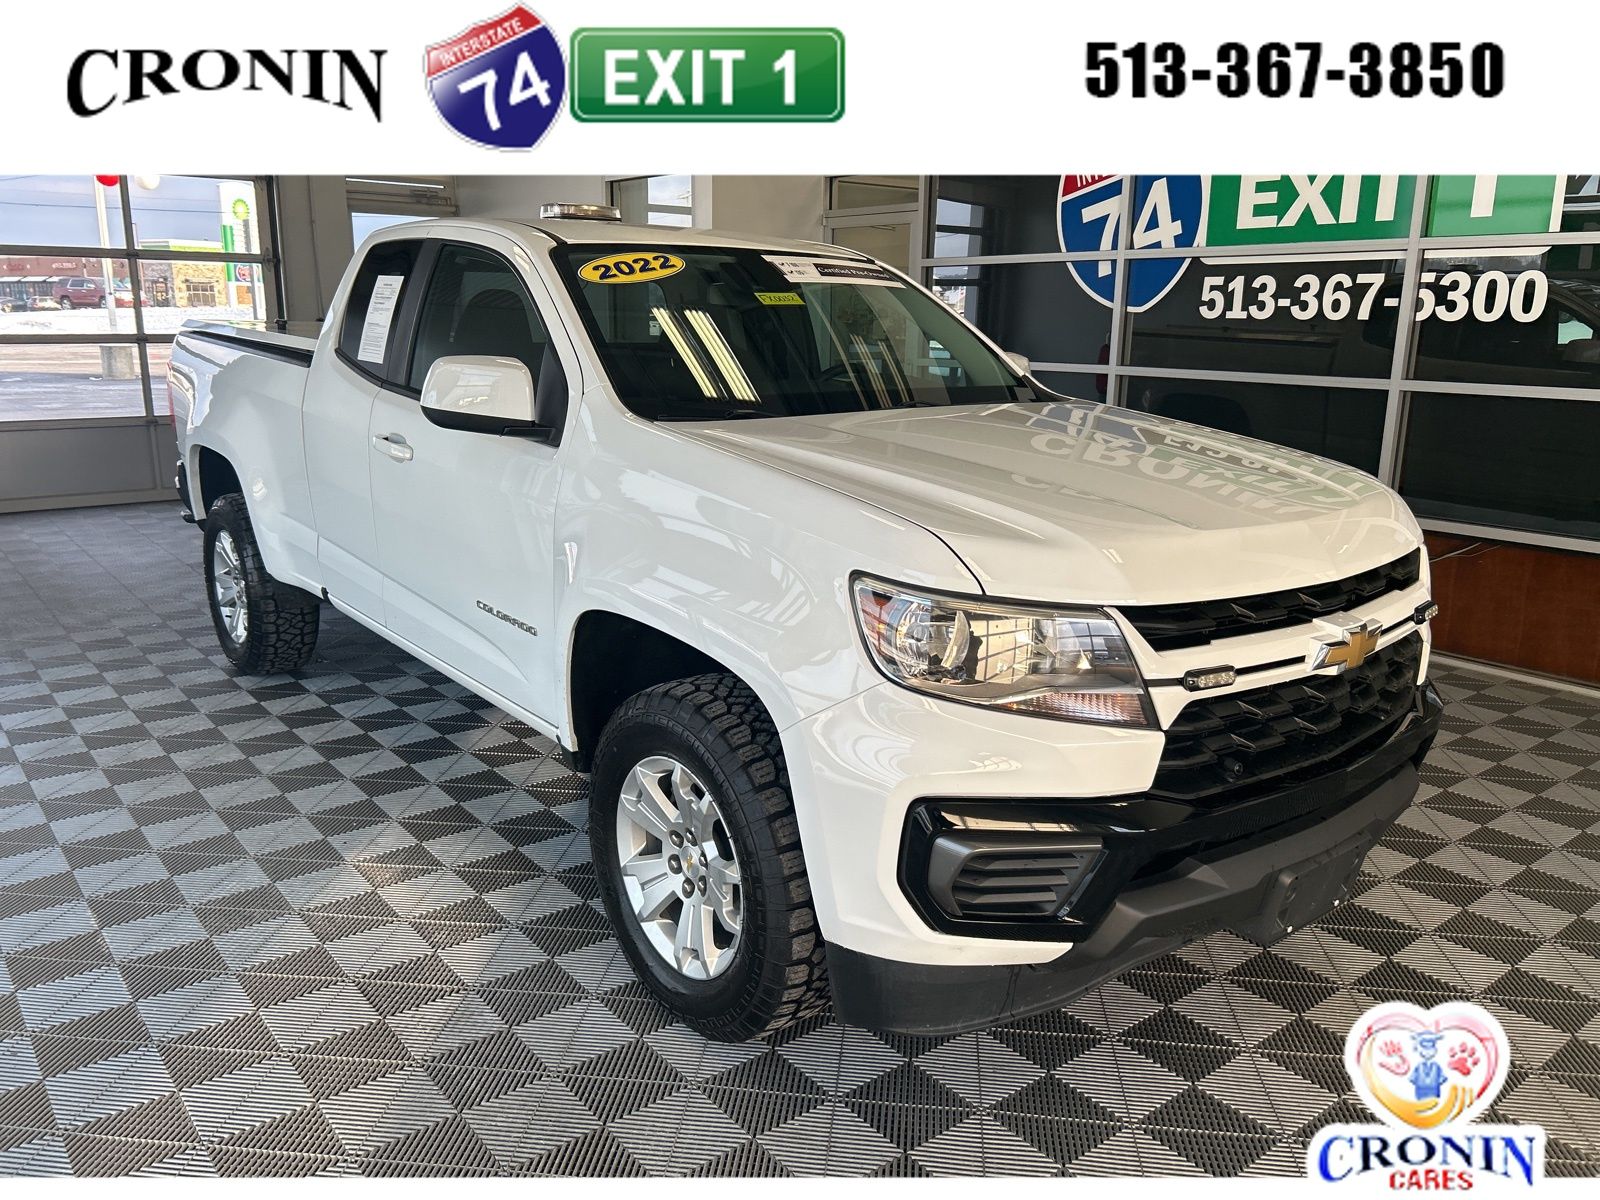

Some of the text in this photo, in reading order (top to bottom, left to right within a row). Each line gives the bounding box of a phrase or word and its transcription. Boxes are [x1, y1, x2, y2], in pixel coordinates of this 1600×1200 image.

[1236, 174, 1399, 230] EXIT
[1081, 177, 1183, 279] 74
[592, 254, 677, 281] 2022
[818, 266, 851, 276] Certified
[476, 599, 538, 637] COLORADO
